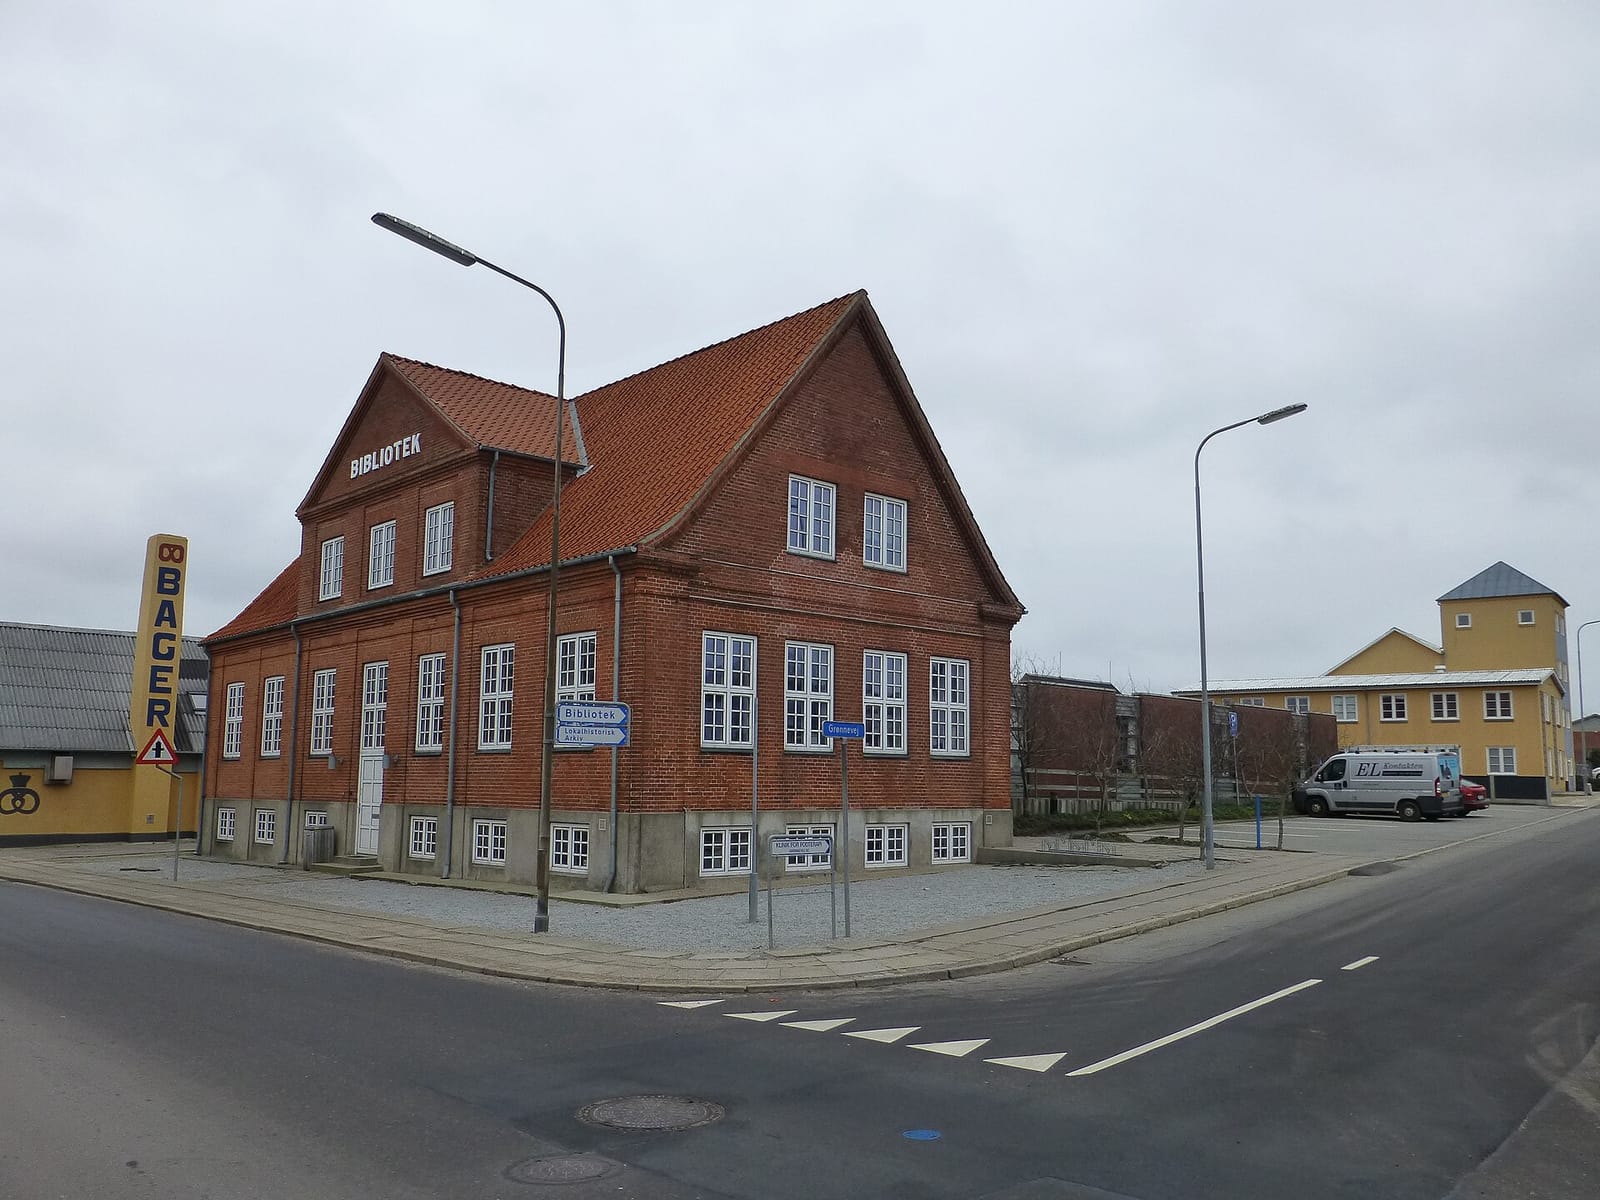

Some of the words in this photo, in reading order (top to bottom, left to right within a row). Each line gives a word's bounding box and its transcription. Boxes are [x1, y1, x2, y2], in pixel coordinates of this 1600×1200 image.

[351, 433, 421, 479] BIBLIOTEK
[147, 566, 181, 727] BAGER
[565, 709, 616, 719] Bibliotek
[564, 728, 615, 736] Lokalhistorisk
[828, 724, 859, 736] Grønnevej
[1355, 762, 1381, 777] EL
